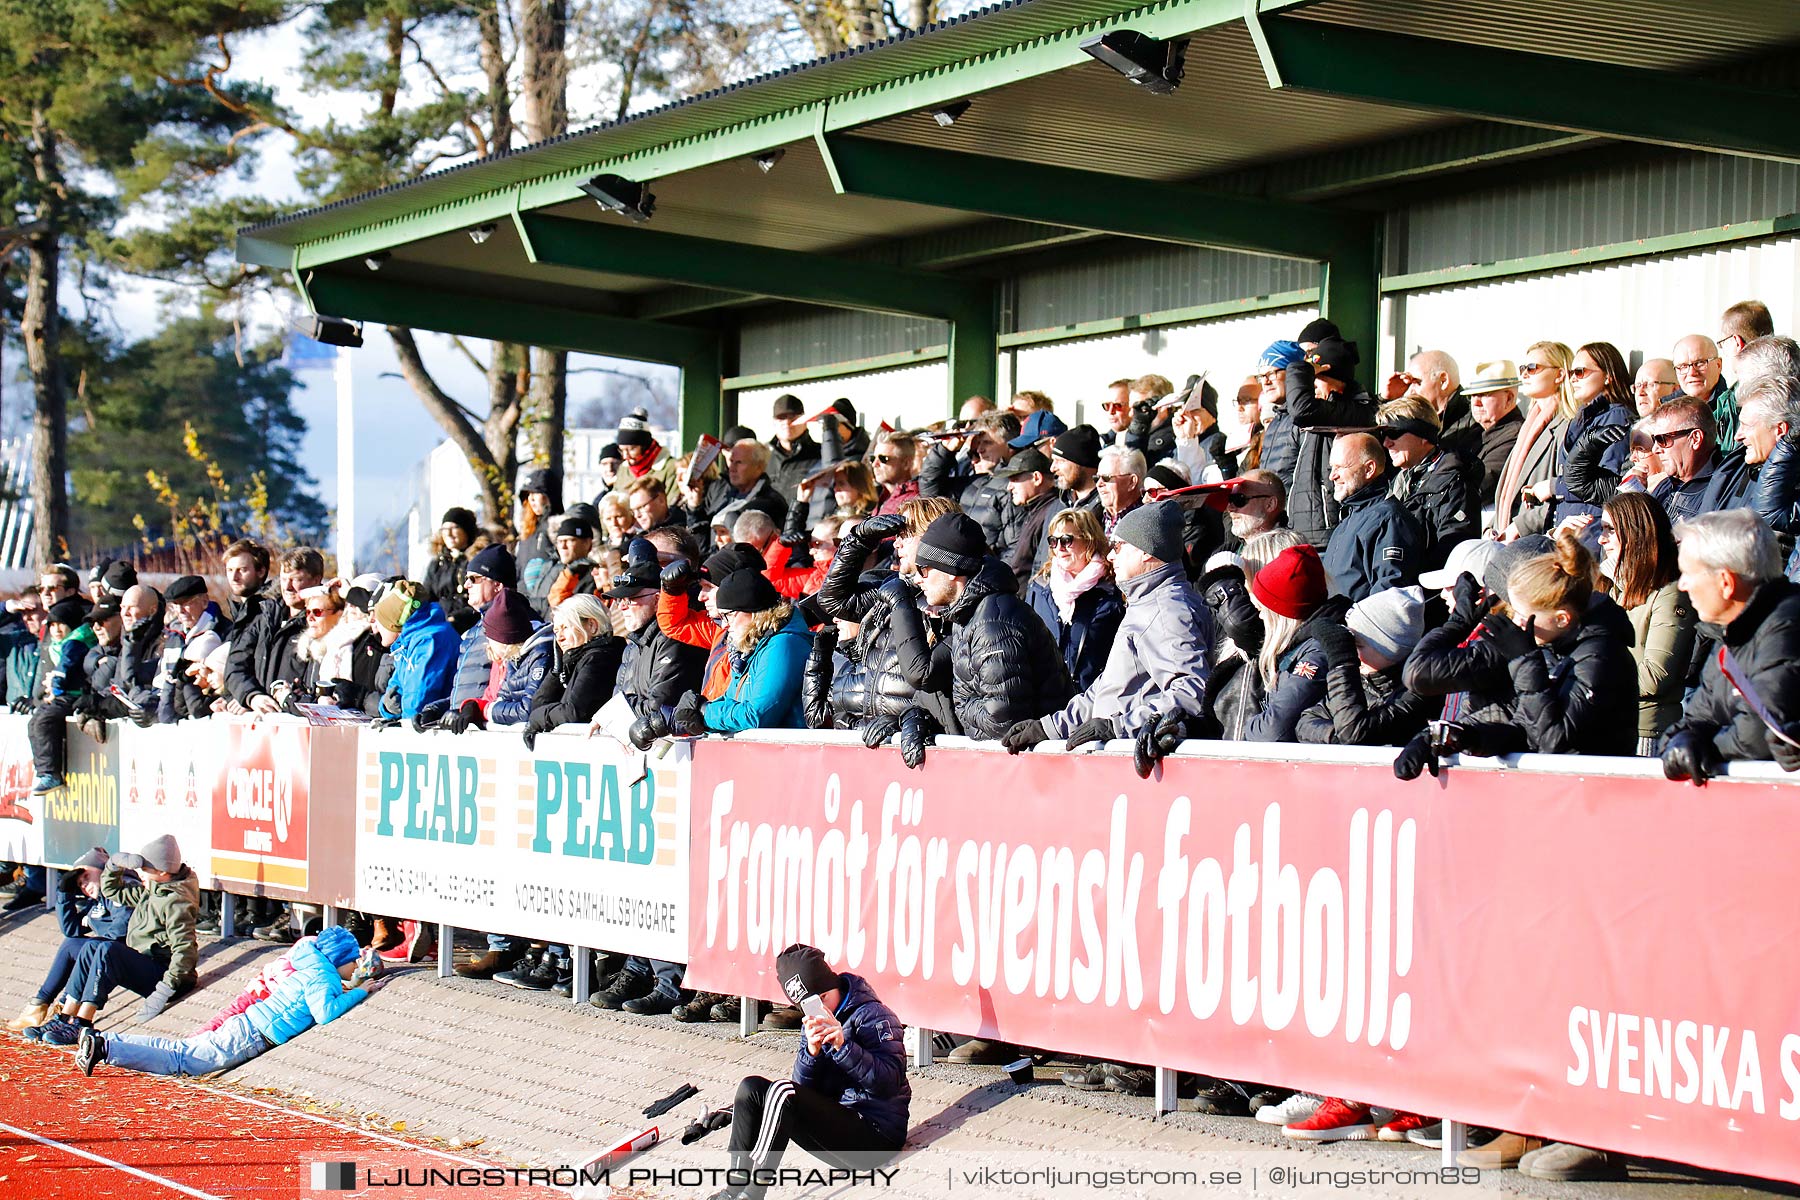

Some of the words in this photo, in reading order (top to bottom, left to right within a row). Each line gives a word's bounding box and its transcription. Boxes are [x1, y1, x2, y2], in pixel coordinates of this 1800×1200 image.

[377, 752, 479, 846] PEAB
[533, 760, 655, 866] PEAB
[515, 882, 564, 917] NORDENS
[706, 772, 869, 969] Framåt
[876, 781, 948, 980] för
[951, 793, 1144, 1011] svensk
[1157, 796, 1417, 1051] fotboll!
[1567, 1005, 1766, 1115] SVENSKA
